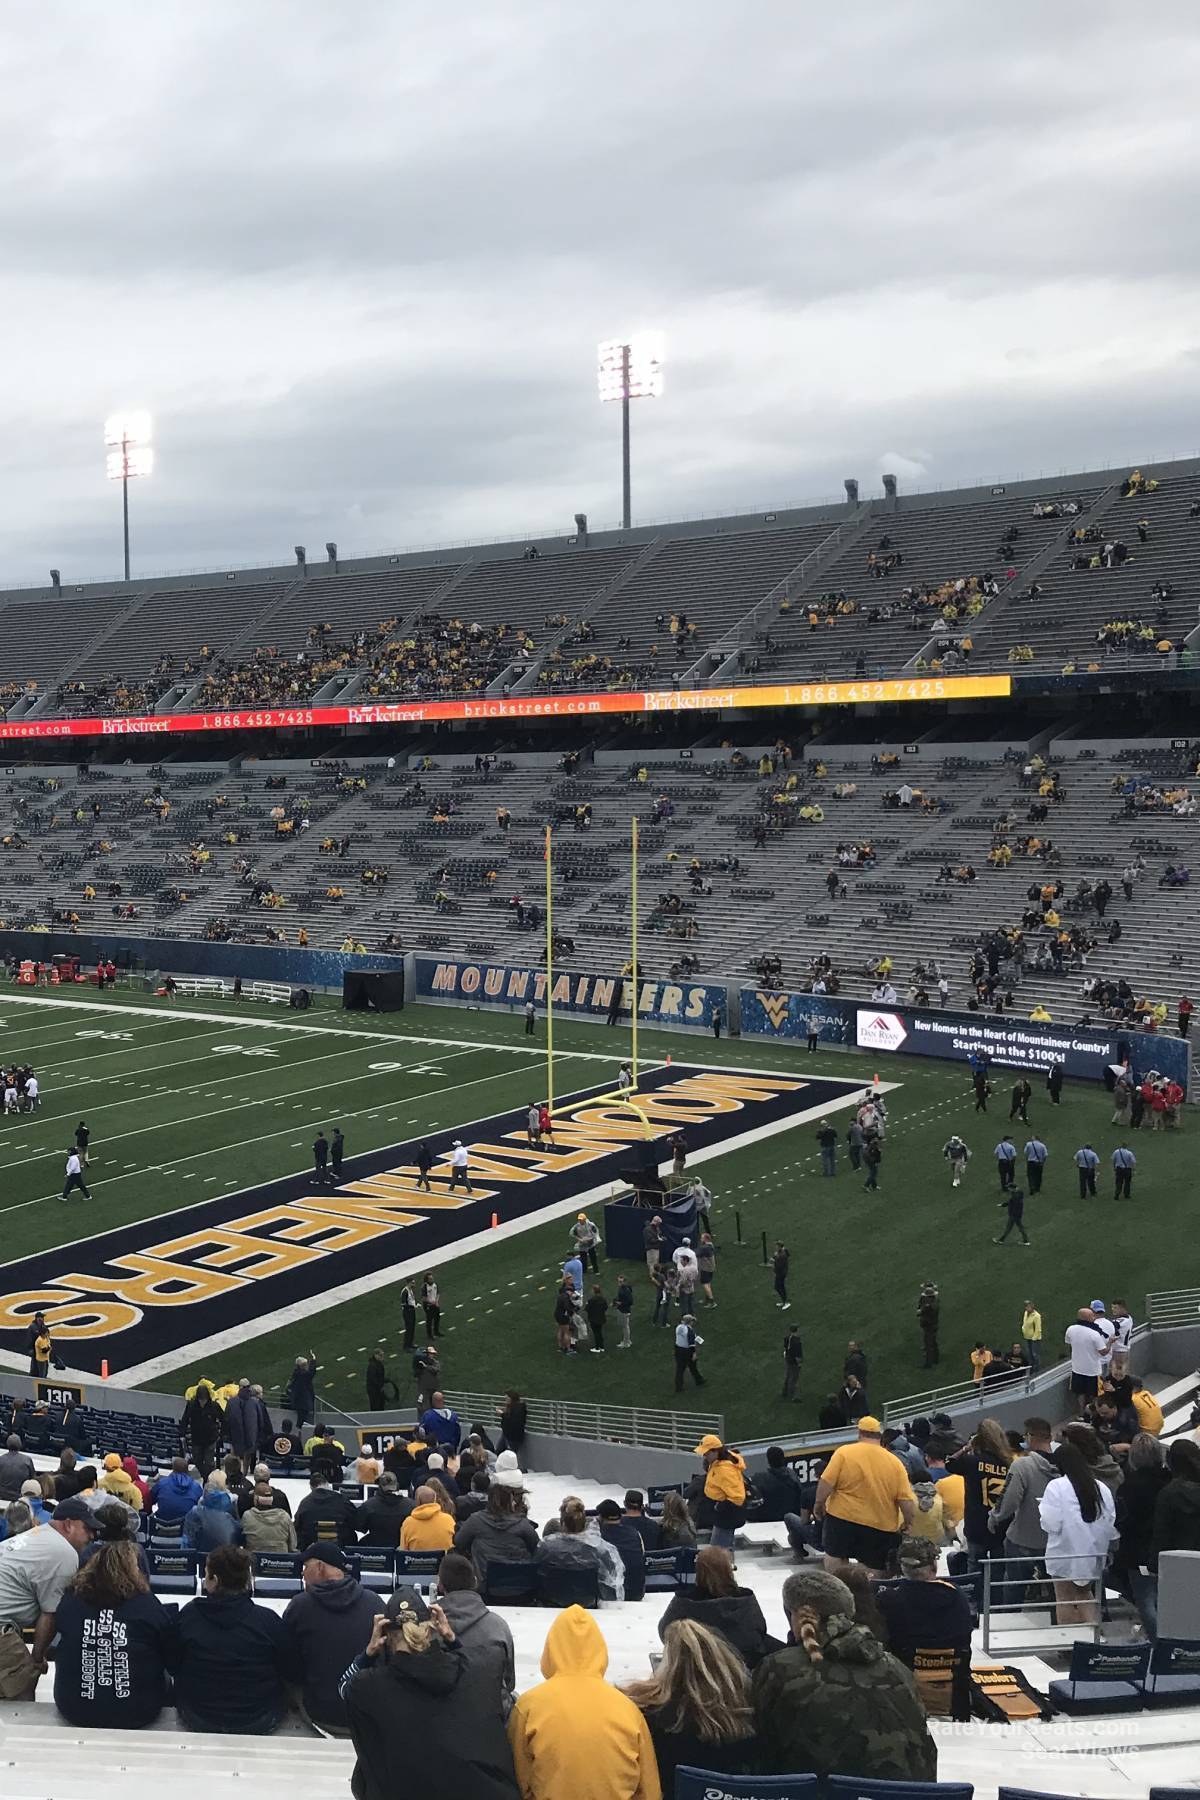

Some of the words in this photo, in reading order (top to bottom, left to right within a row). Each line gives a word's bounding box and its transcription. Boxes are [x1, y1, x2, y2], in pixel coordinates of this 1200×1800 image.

[102, 719, 170, 734] Brickstreet
[202, 711, 313, 728] 1.866.452.7425
[348, 707, 426, 723] Brickstreet
[464, 700, 601, 716] brickstreet.com
[644, 692, 735, 711] Brickstreet
[783, 682, 945, 703] 1.866.452.7425
[431, 963, 707, 1018] MOUNTAINEERS
[914, 1019, 932, 1031] New
[932, 1022, 959, 1035] Homes
[959, 1025, 968, 1035] in
[968, 1026, 983, 1037] the
[983, 1028, 1006, 1040] Heart
[1007, 1031, 1017, 1041] of
[1017, 1033, 1071, 1049] Mountaineer
[1071, 1039, 1110, 1056] Country!
[996, 1044, 1006, 1055] in
[1007, 1045, 1026, 1058] the
[46, 1388, 73, 1403] 130
[99, 1609, 114, 1625] 55
[83, 1619, 96, 1637] 51
[112, 1621, 127, 1640] 56
[97, 1638, 113, 1686] STILLS
[913, 1655, 961, 1668] Steelers
[1101, 1654, 1142, 1664] Panhandle
[81, 1649, 96, 1700] ABBOTT
[114, 1651, 131, 1698] STILLS
[970, 1672, 1017, 1685] Steelers
